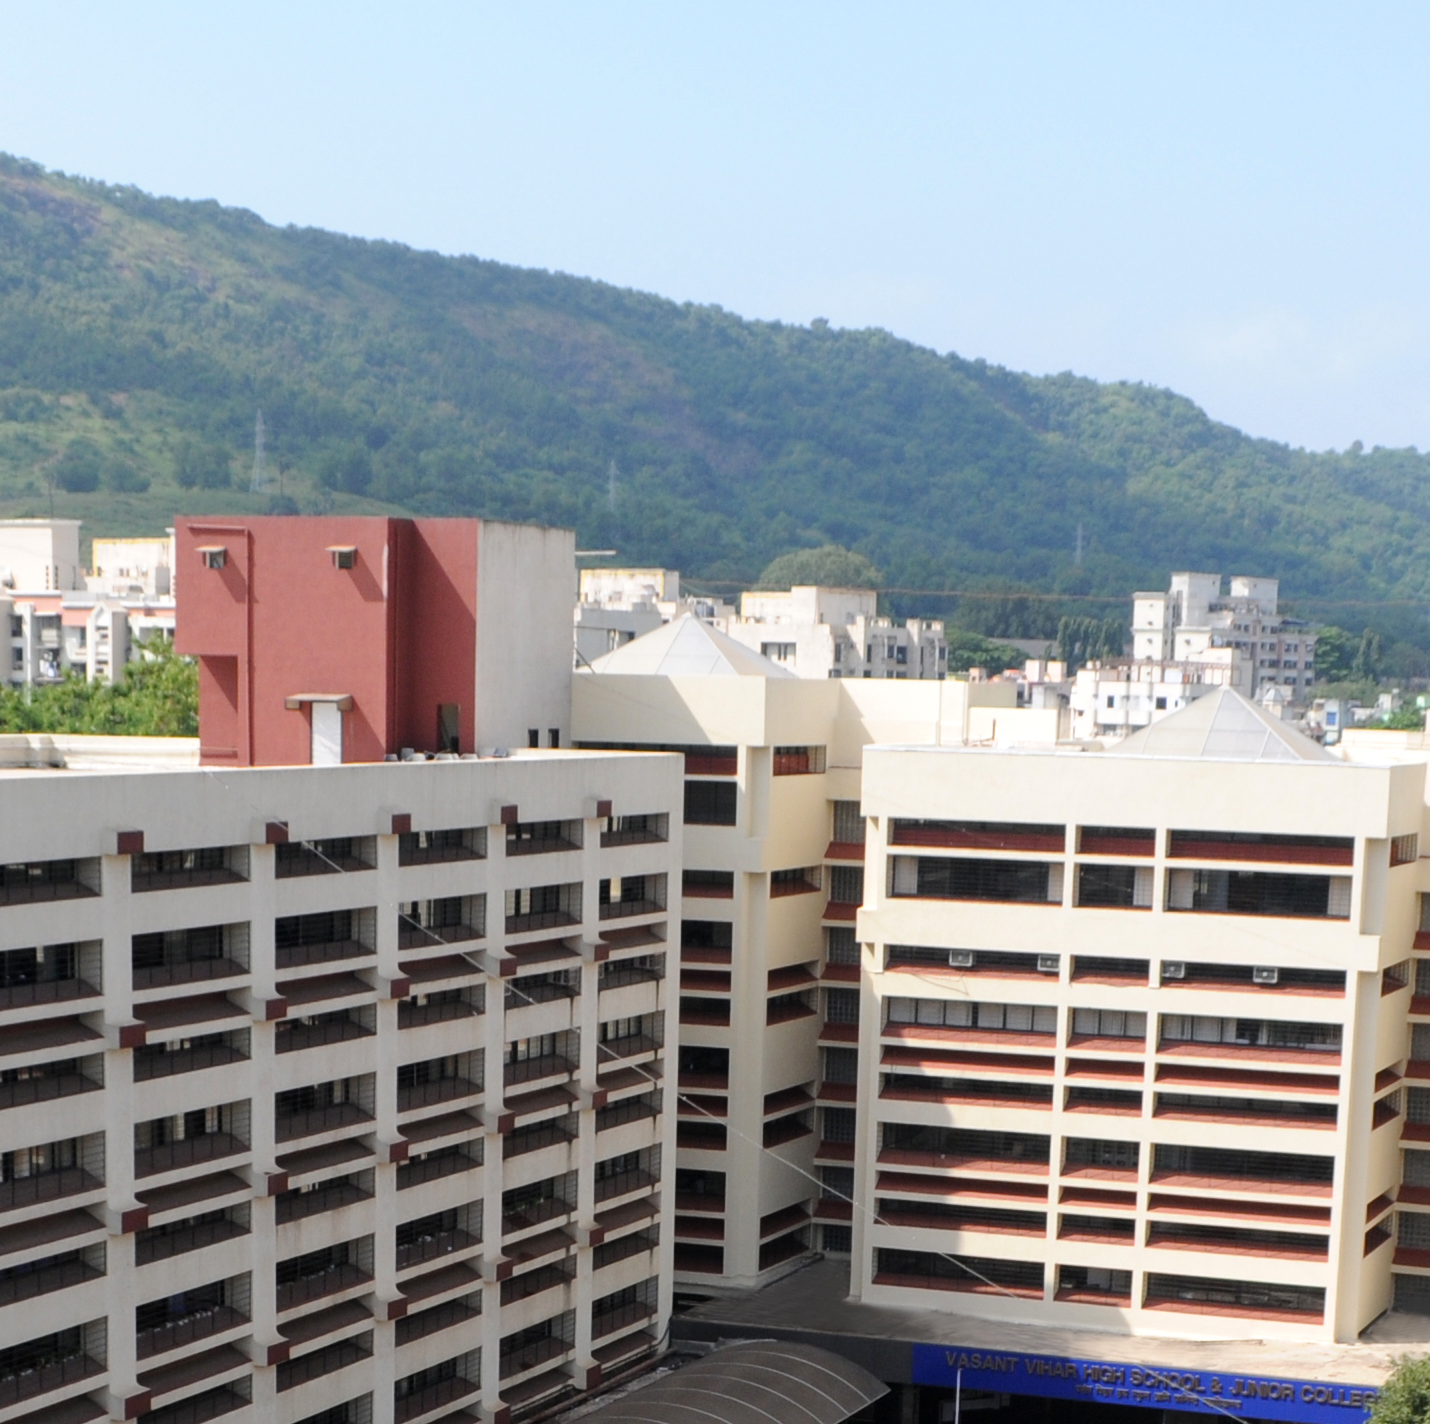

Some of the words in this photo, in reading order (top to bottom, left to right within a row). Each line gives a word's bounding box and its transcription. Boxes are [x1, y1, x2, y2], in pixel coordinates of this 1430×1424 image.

[945, 1350, 1019, 1373] VASANT
[1025, 1358, 1077, 1379] VIHAR
[1082, 1363, 1125, 1384] HIGH
[1129, 1367, 1206, 1393] SCHOOL
[1209, 1376, 1224, 1393] &
[1228, 1378, 1295, 1400] JUNIOR
[1300, 1384, 1378, 1408] COLLEG
